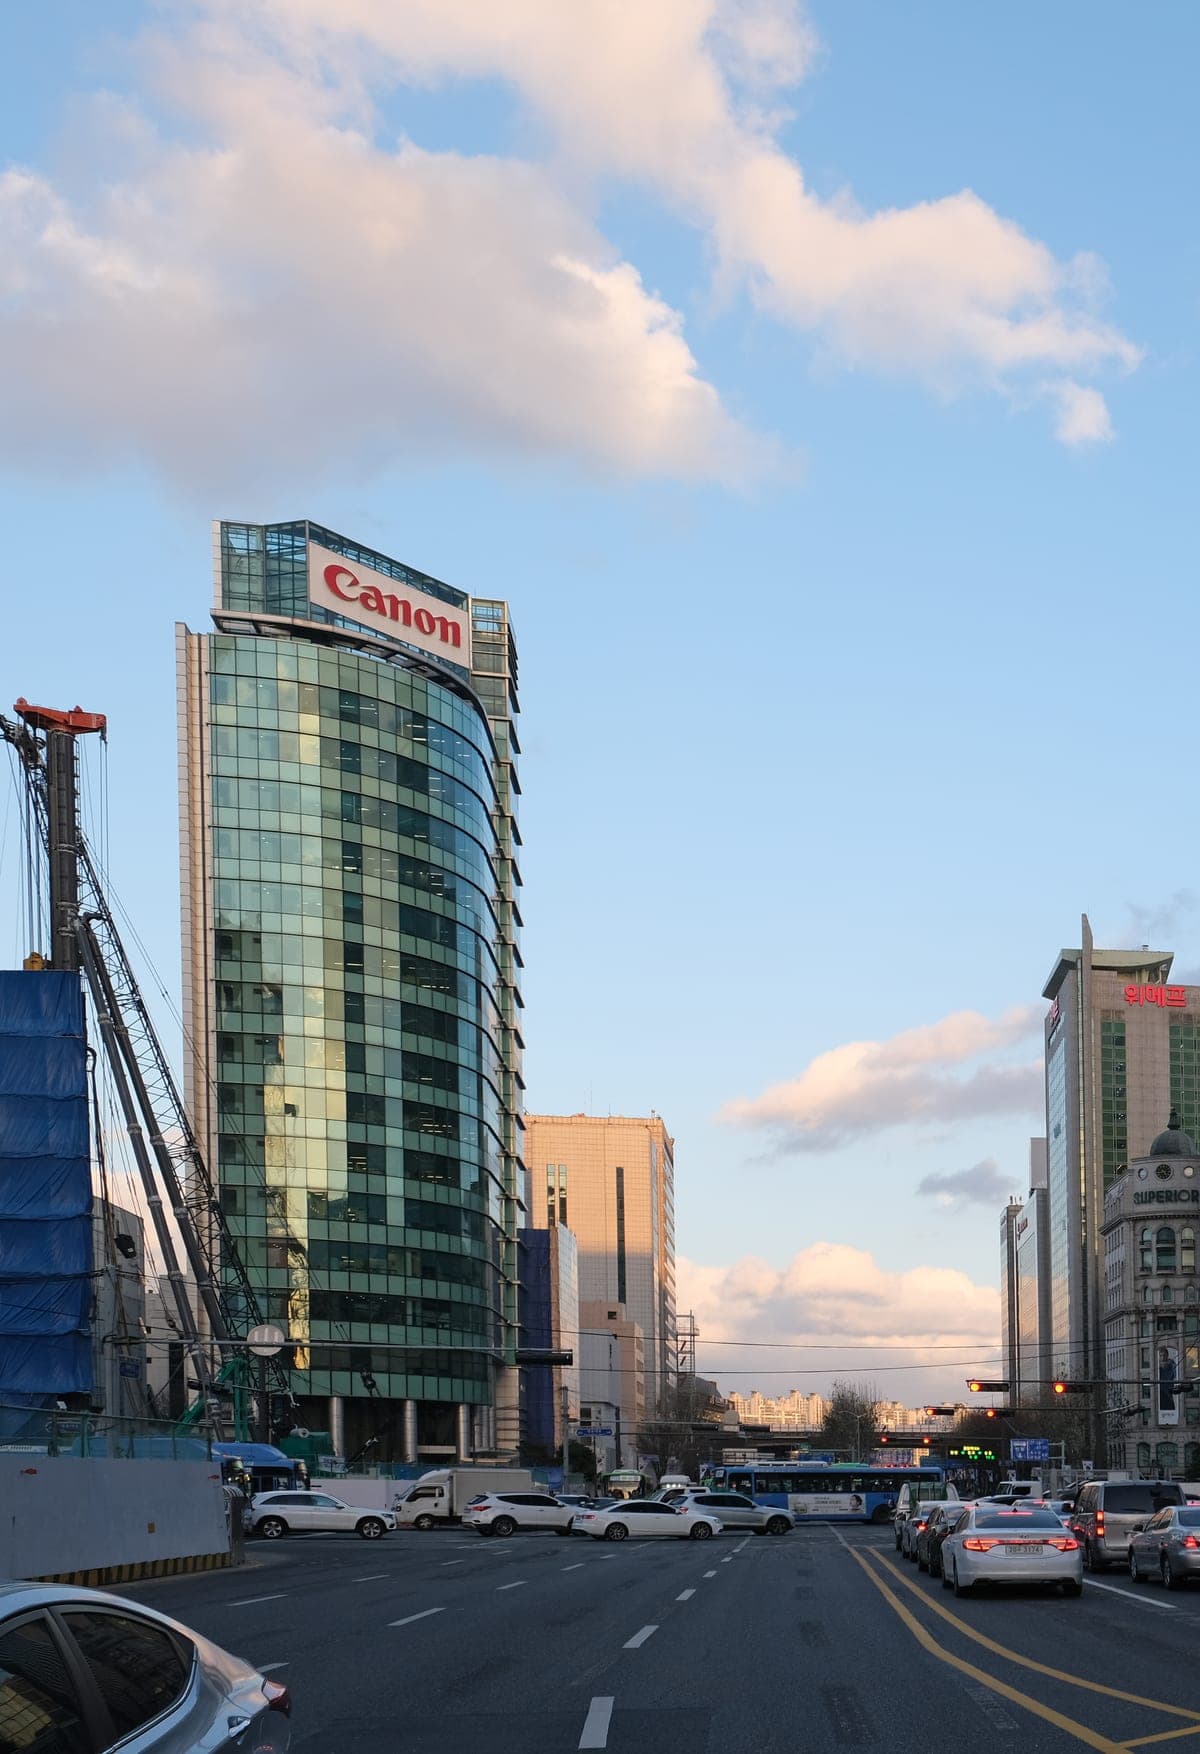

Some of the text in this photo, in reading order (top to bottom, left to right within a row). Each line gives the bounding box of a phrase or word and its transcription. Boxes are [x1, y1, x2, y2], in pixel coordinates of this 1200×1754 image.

[324, 564, 462, 648] Canon
[1124, 984, 1187, 1008] 위메프
[1133, 1189, 1200, 1205] SUPERIOR
